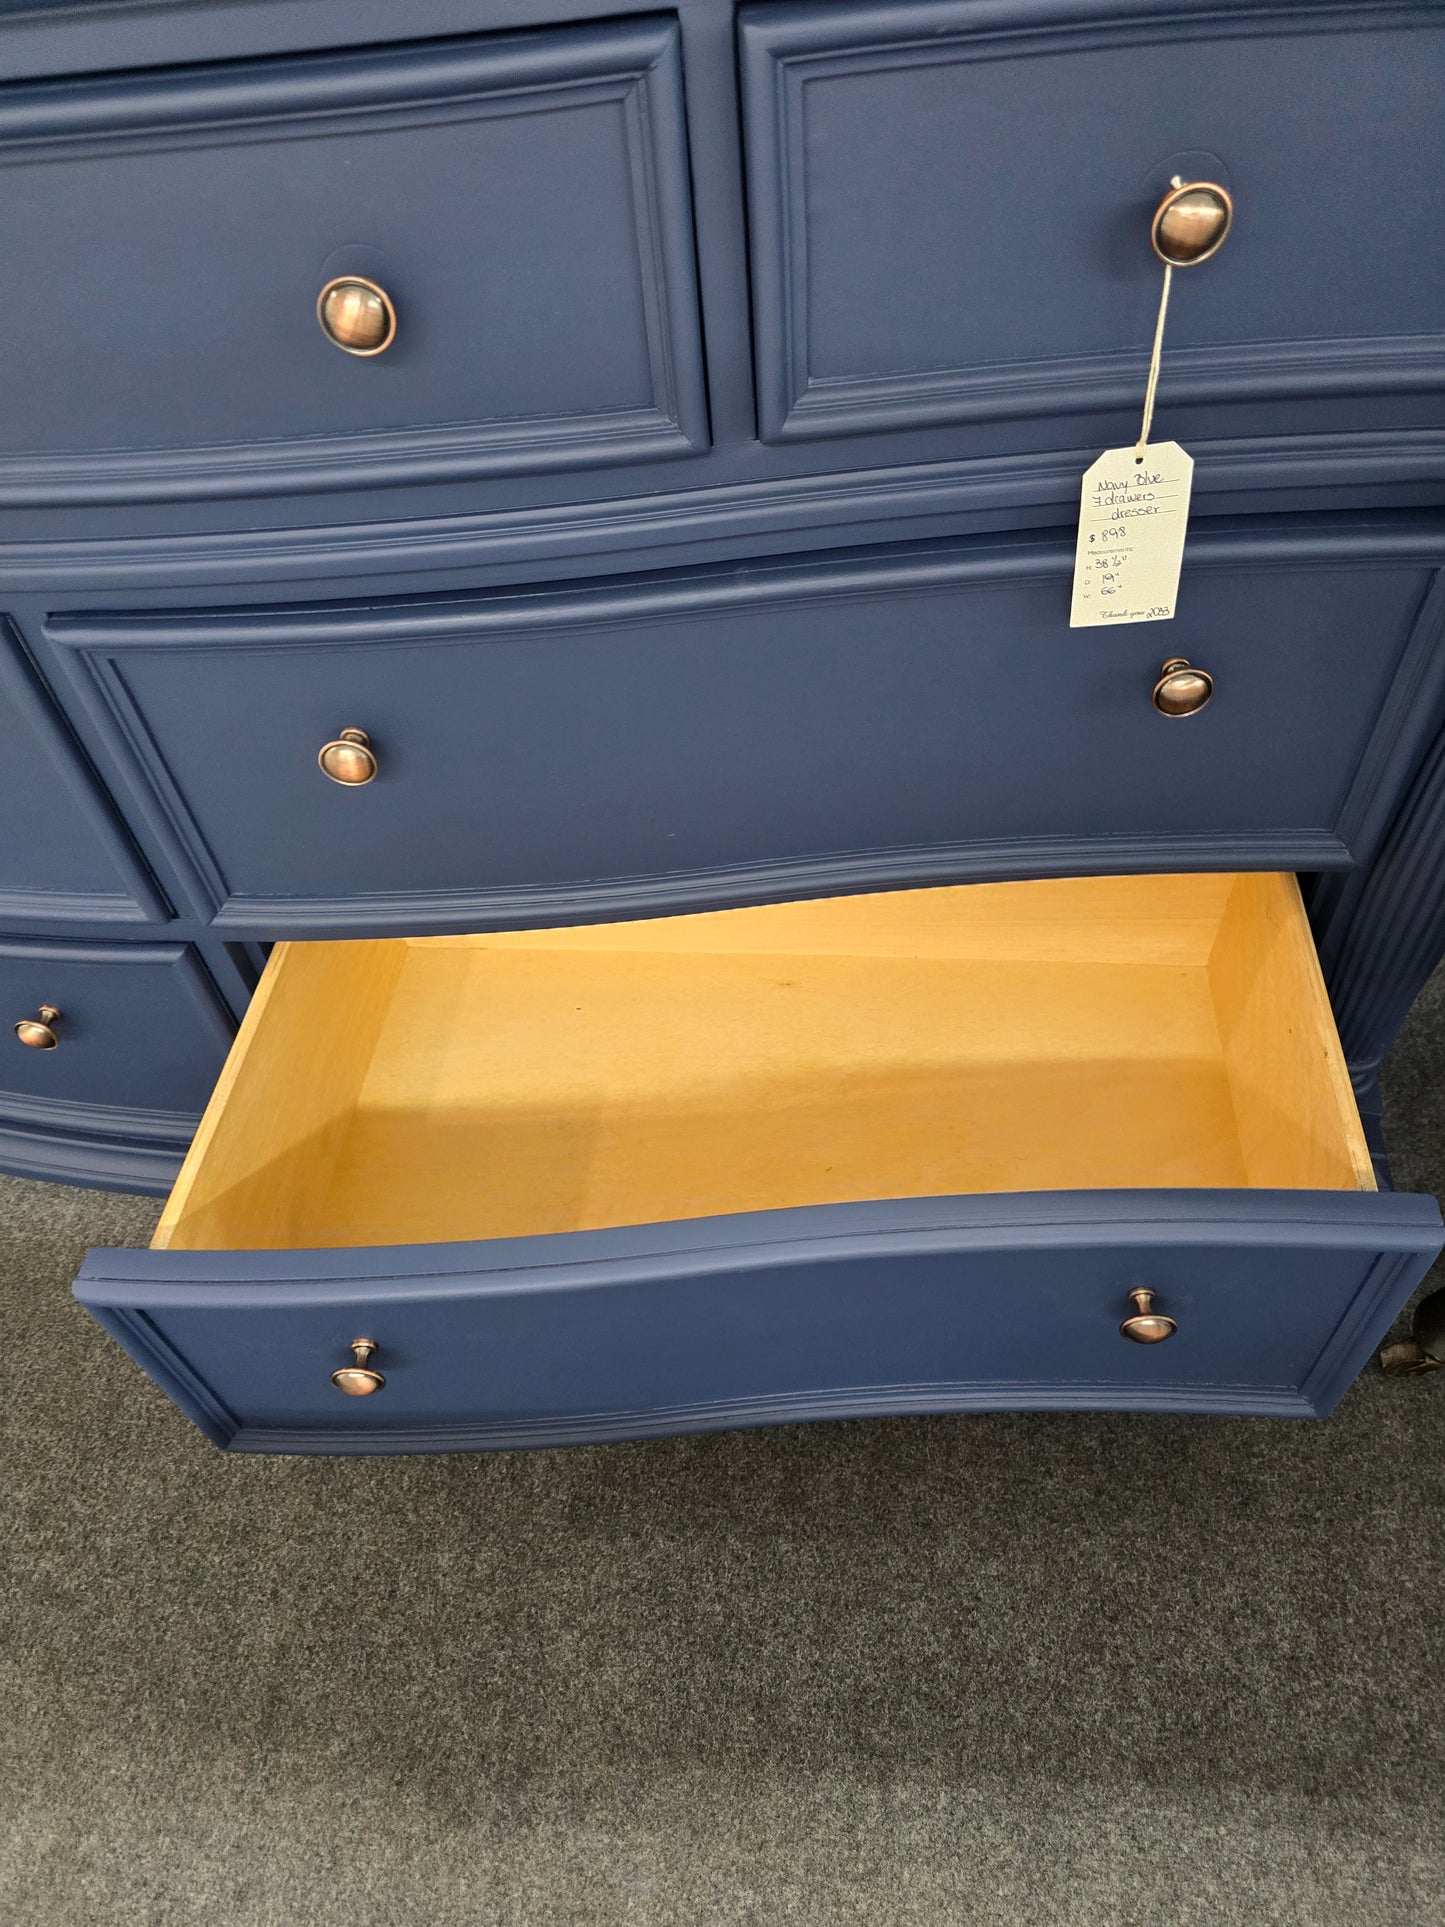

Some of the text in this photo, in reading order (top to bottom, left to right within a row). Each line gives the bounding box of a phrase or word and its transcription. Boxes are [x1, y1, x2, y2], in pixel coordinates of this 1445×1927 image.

[1098, 471, 1164, 494] Navy Blue
[1092, 491, 1155, 506] 7 drawers
[1111, 506, 1160, 520] dresser
[1101, 526, 1126, 542] 898
